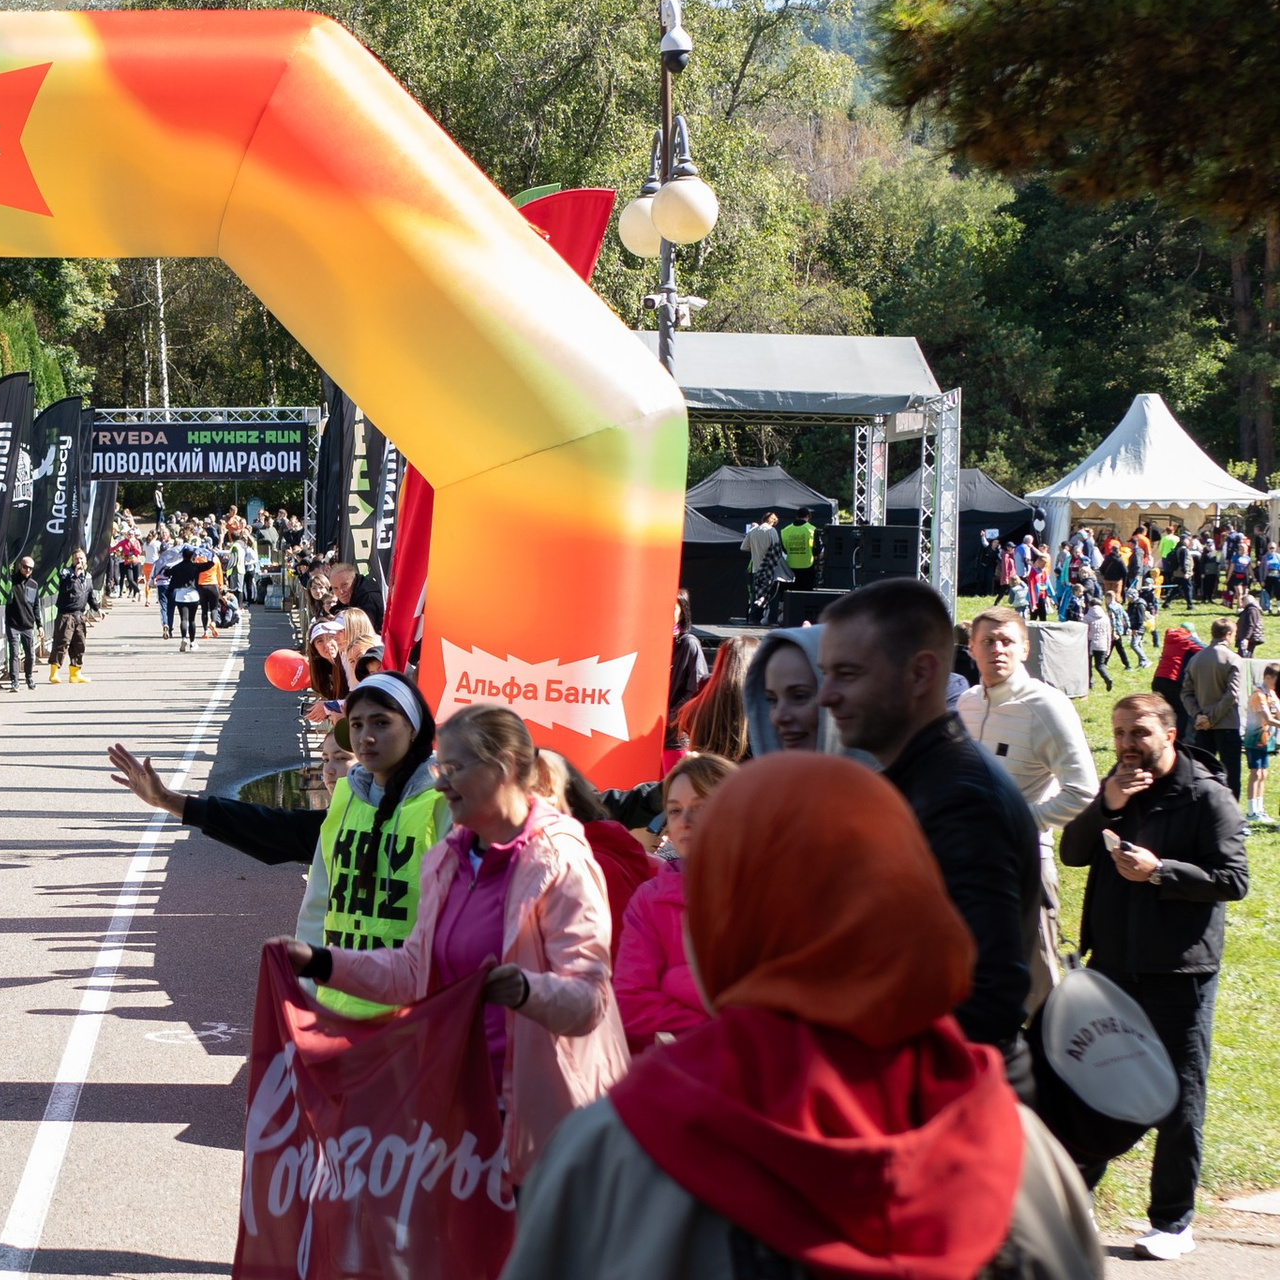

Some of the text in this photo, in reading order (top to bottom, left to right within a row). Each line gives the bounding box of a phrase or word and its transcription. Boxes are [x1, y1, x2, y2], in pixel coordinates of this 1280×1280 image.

[46, 436, 72, 534] Адельсу
[208, 450, 301, 474] МАРАФОН
[454, 671, 612, 705] Альфа Банк
[328, 872, 409, 921] KAZ
[1065, 1027, 1094, 1062] AND
[1090, 1016, 1120, 1037] THE
